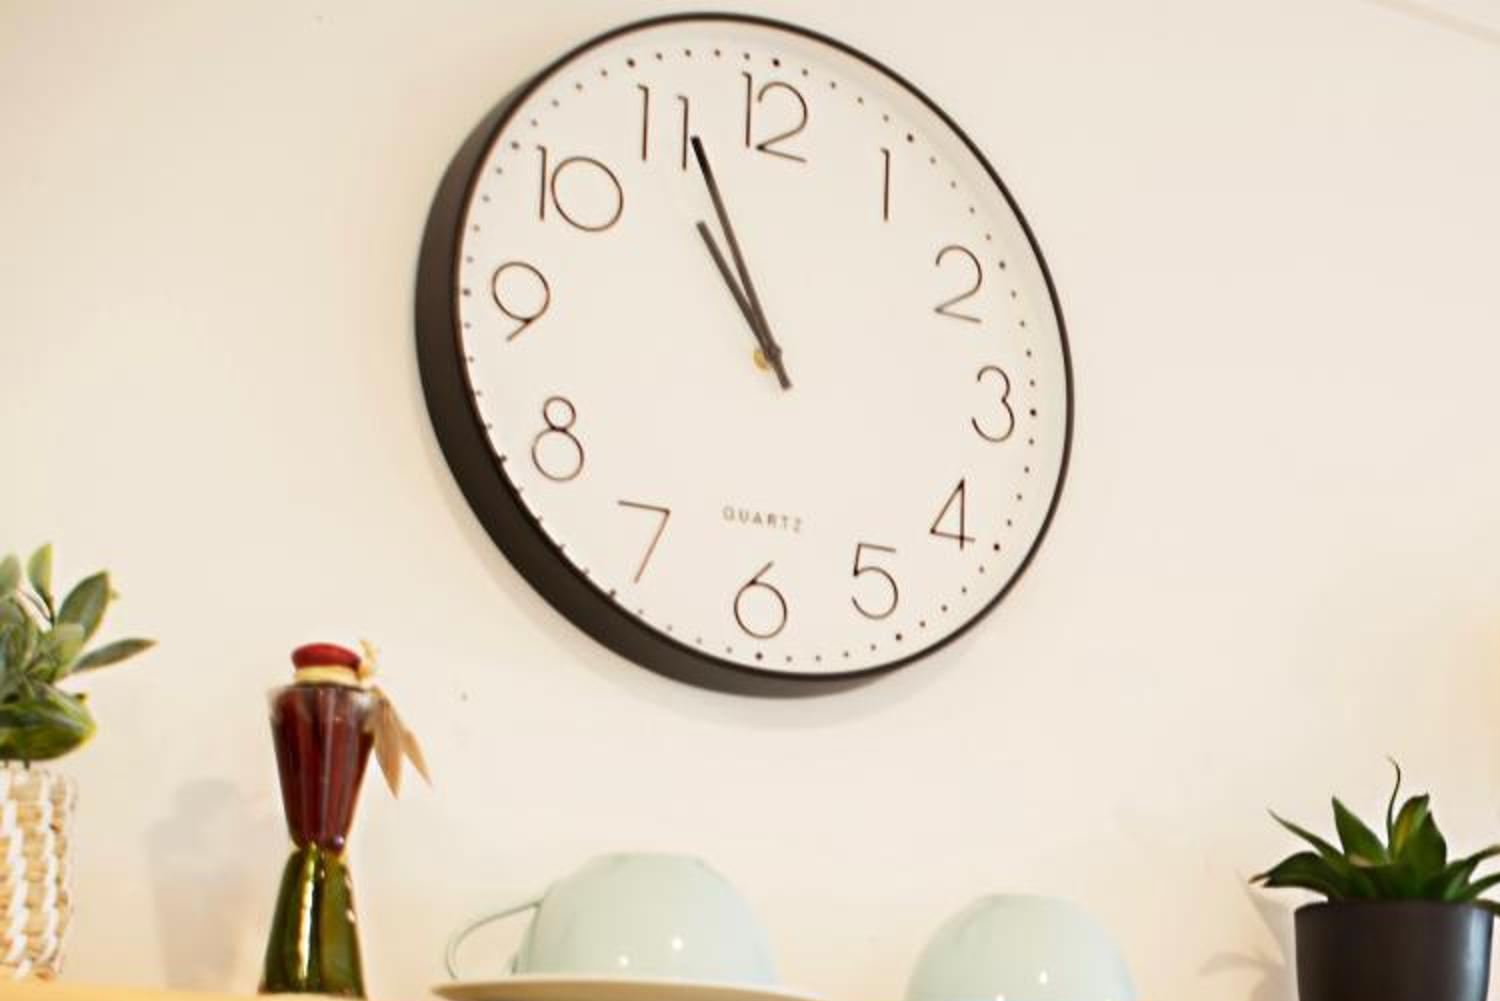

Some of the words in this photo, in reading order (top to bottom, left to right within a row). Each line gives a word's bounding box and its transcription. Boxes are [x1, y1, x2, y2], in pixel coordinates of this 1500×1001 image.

[636, 83, 689, 172] 11
[741, 70, 809, 164] 12
[536, 144, 624, 233] 10
[879, 147, 890, 222] 1
[490, 261, 551, 342] 9
[933, 245, 983, 324] 2
[530, 395, 585, 483] 8
[971, 365, 1015, 443] 3
[617, 499, 671, 584] 7
[721, 505, 803, 534] QUARTZ
[929, 476, 976, 551] 4
[733, 561, 788, 640] 6
[851, 542, 899, 621] 5
